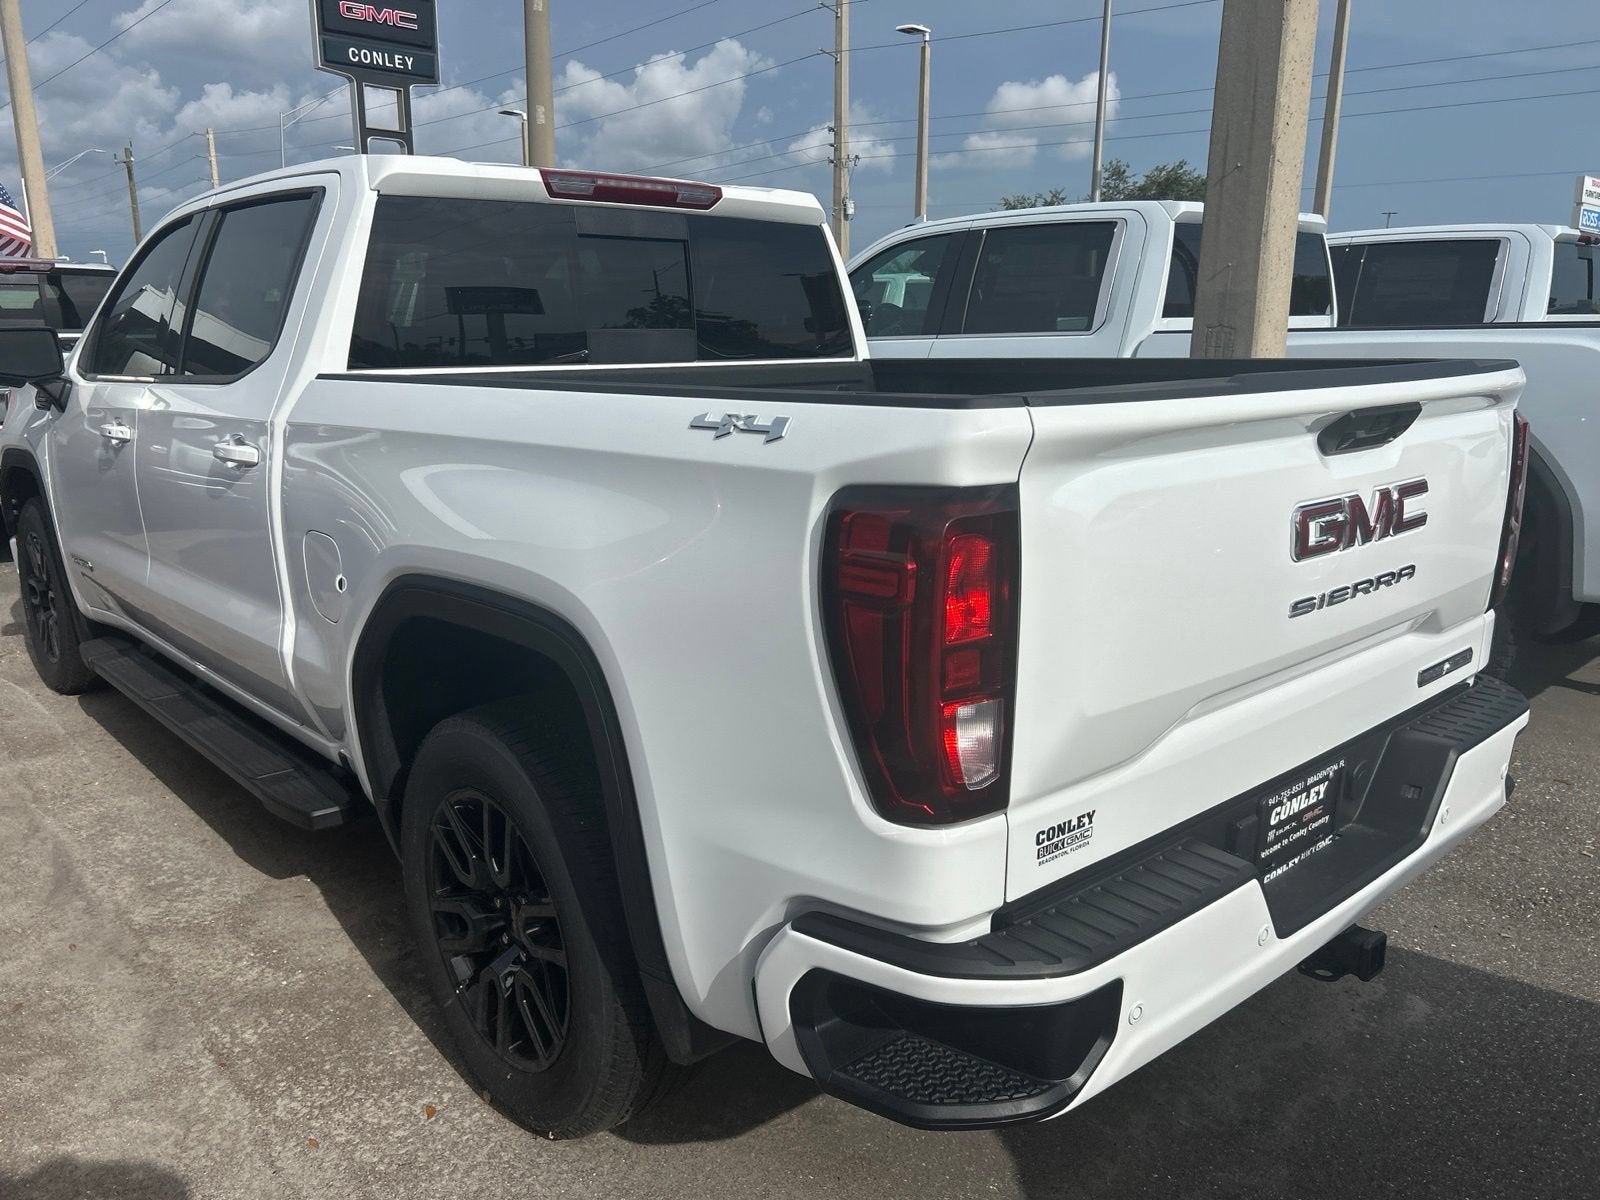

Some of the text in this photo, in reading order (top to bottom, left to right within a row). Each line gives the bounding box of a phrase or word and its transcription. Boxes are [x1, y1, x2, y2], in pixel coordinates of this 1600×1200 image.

[339, 0, 417, 30] GMC
[348, 47, 414, 70] CONLEY
[1290, 475, 1429, 563] GMC
[1287, 564, 1416, 619] SIERRA
[1270, 781, 1329, 826] CONLEY
[1035, 809, 1096, 847] CONLEY
[1038, 828, 1091, 859] BUICK GMC
[1263, 855, 1301, 884] CONLEY
